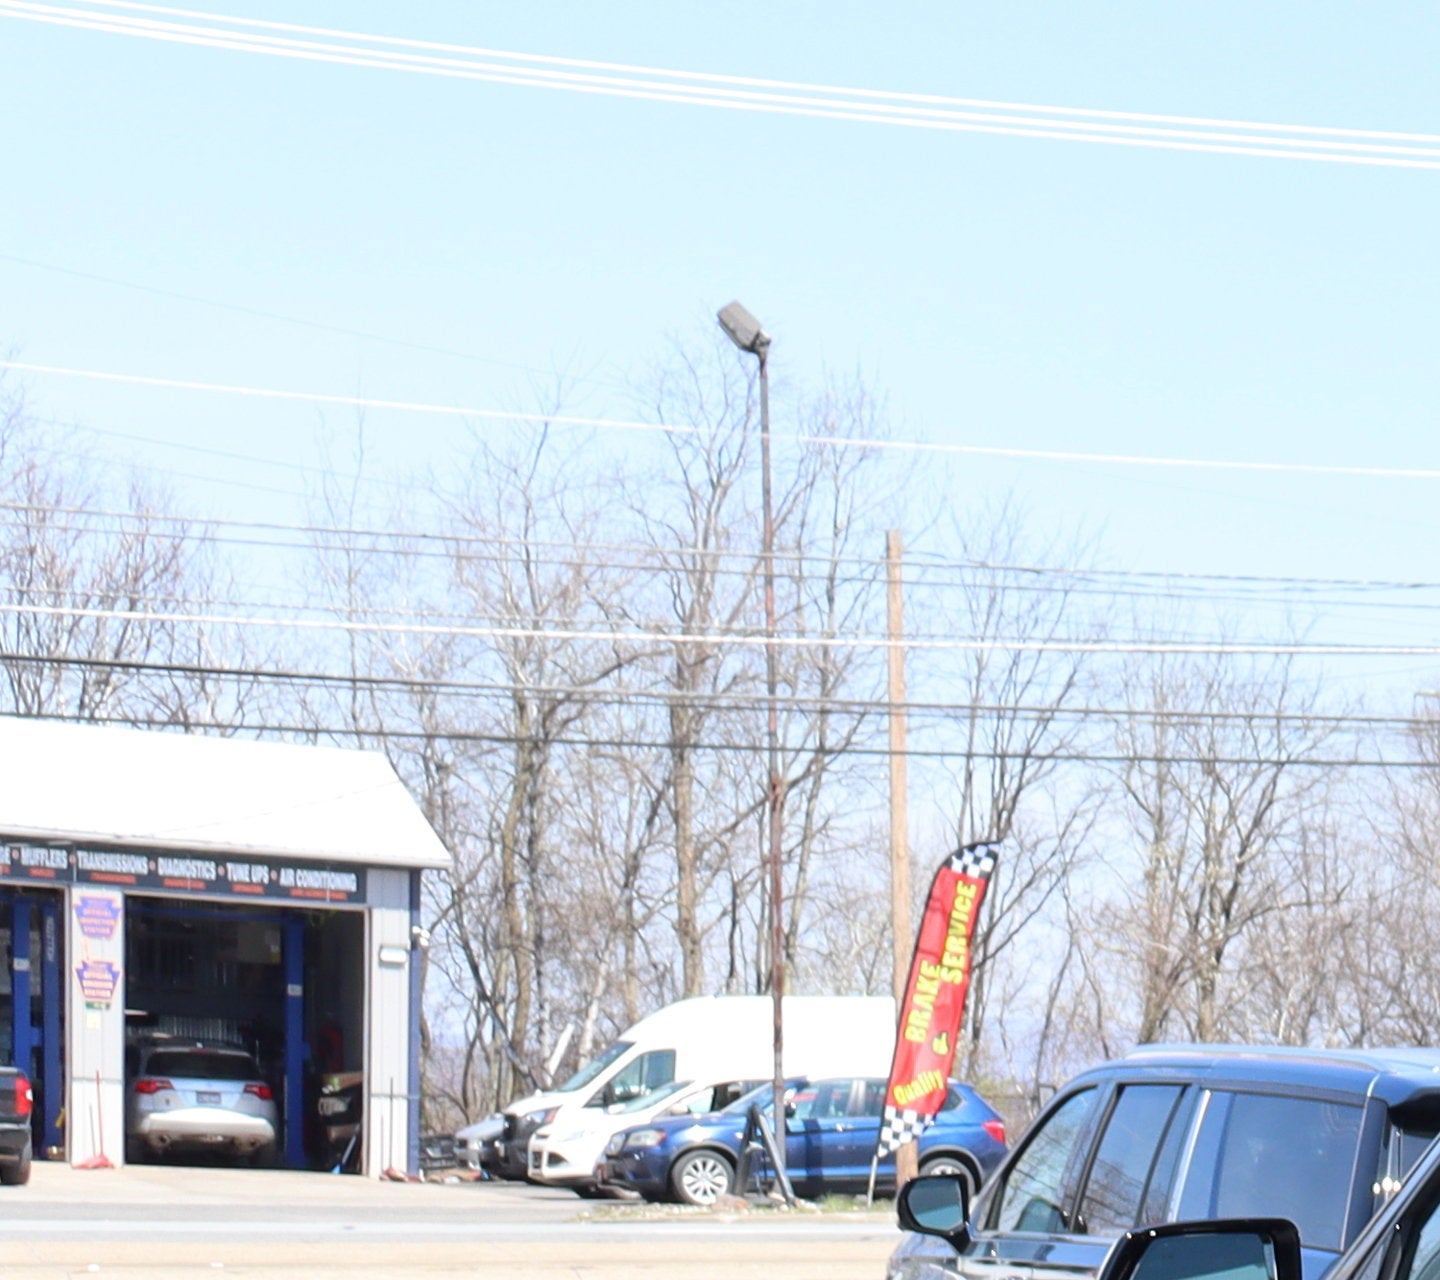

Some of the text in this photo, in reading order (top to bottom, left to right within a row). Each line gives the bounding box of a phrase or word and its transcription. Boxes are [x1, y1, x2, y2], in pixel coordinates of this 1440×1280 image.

[20, 845, 68, 869] MUFFLERS
[76, 850, 149, 876] TRANSMISSIONS
[157, 856, 217, 881] DIAGNOSTICS
[225, 862, 250, 883] TUNE
[251, 864, 270, 885] UPS
[279, 867, 295, 888] AIR
[296, 868, 358, 893] CONDITIONING
[938, 879, 979, 986] SERVICE
[904, 959, 941, 1044] BRAKE
[893, 1069, 945, 1106] Quality
